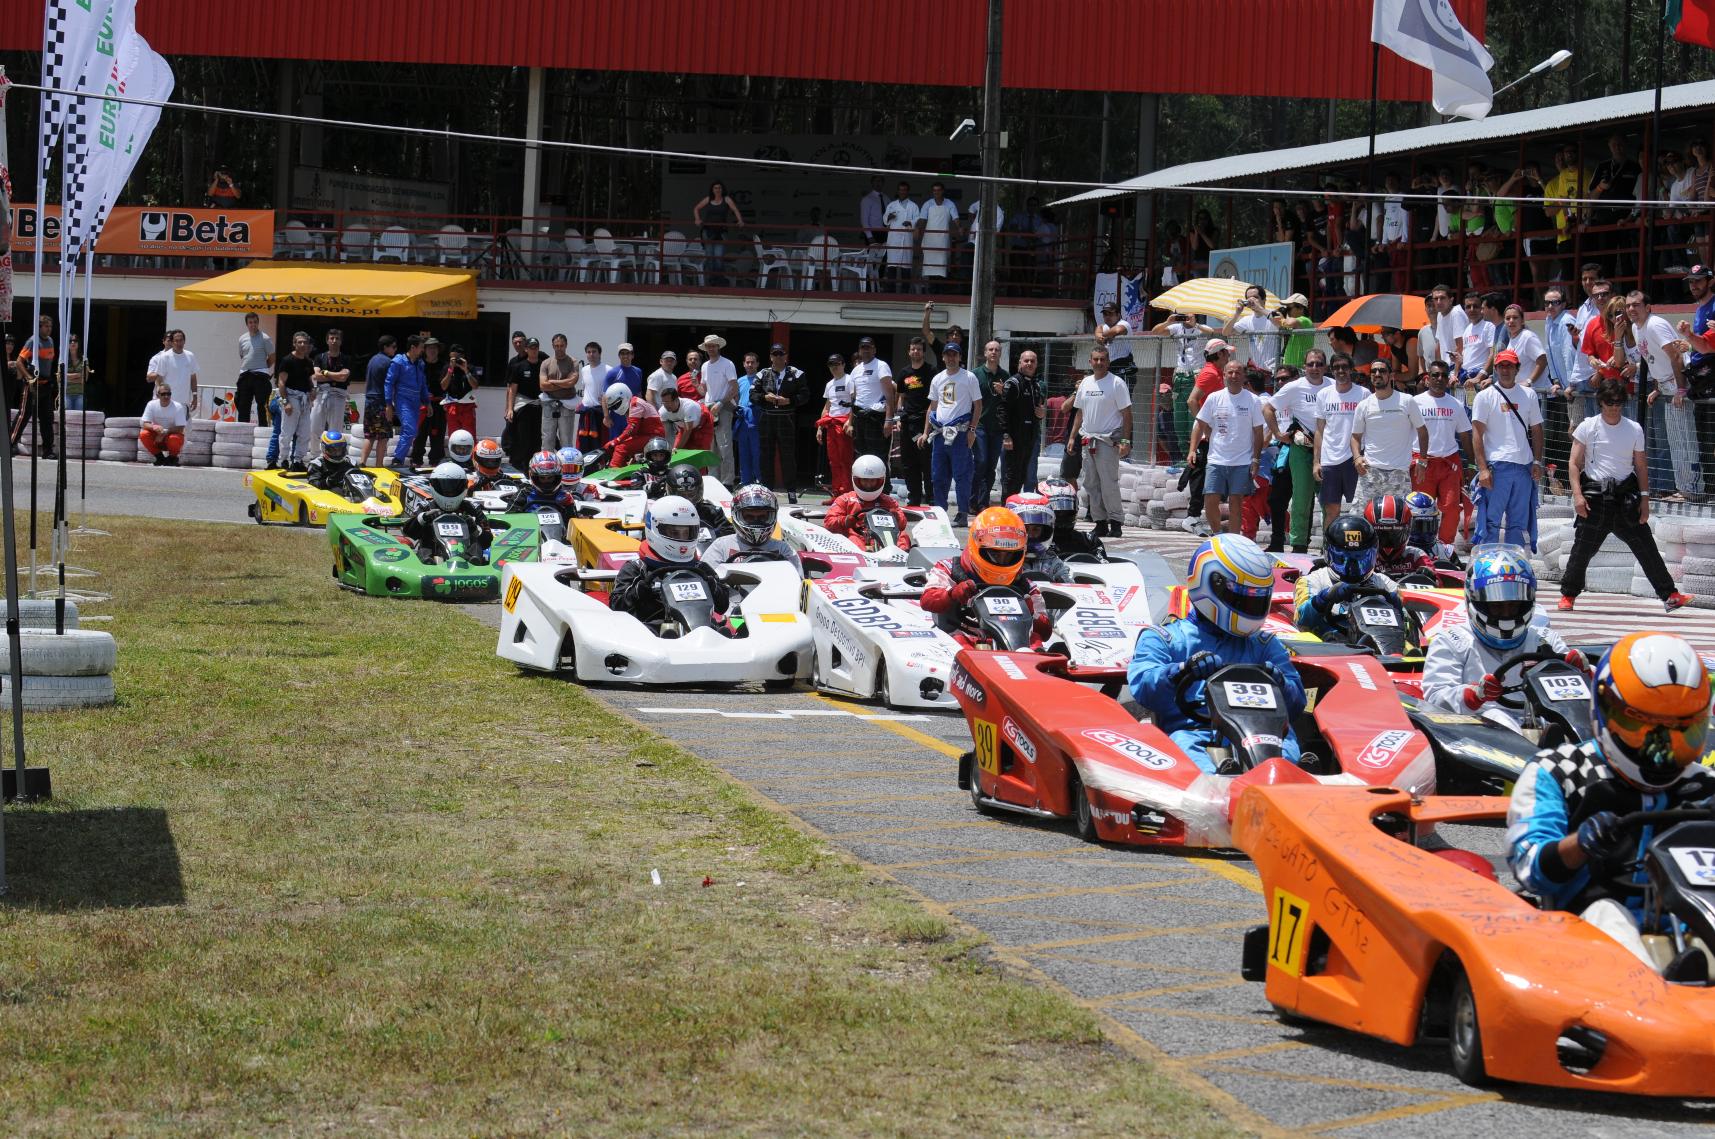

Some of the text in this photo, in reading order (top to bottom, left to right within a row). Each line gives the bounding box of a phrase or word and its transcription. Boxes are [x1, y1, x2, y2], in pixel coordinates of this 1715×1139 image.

[172, 213, 250, 244] Beta
[214, 302, 382, 316] www.pestronix.pt
[1325, 402, 1358, 412] UNITRIP
[1421, 407, 1454, 417] UNITRIP
[1345, 531, 1362, 542] tvi
[454, 578, 488, 593] JOGOS
[675, 583, 698, 592] 129
[1366, 609, 1391, 618] 99
[1231, 683, 1268, 696] 39
[1543, 678, 1583, 688] 103
[977, 723, 993, 769] 39
[1015, 731, 1035, 759] TOOLS
[1119, 740, 1169, 767] TOOLS
[1271, 896, 1302, 965] 17
